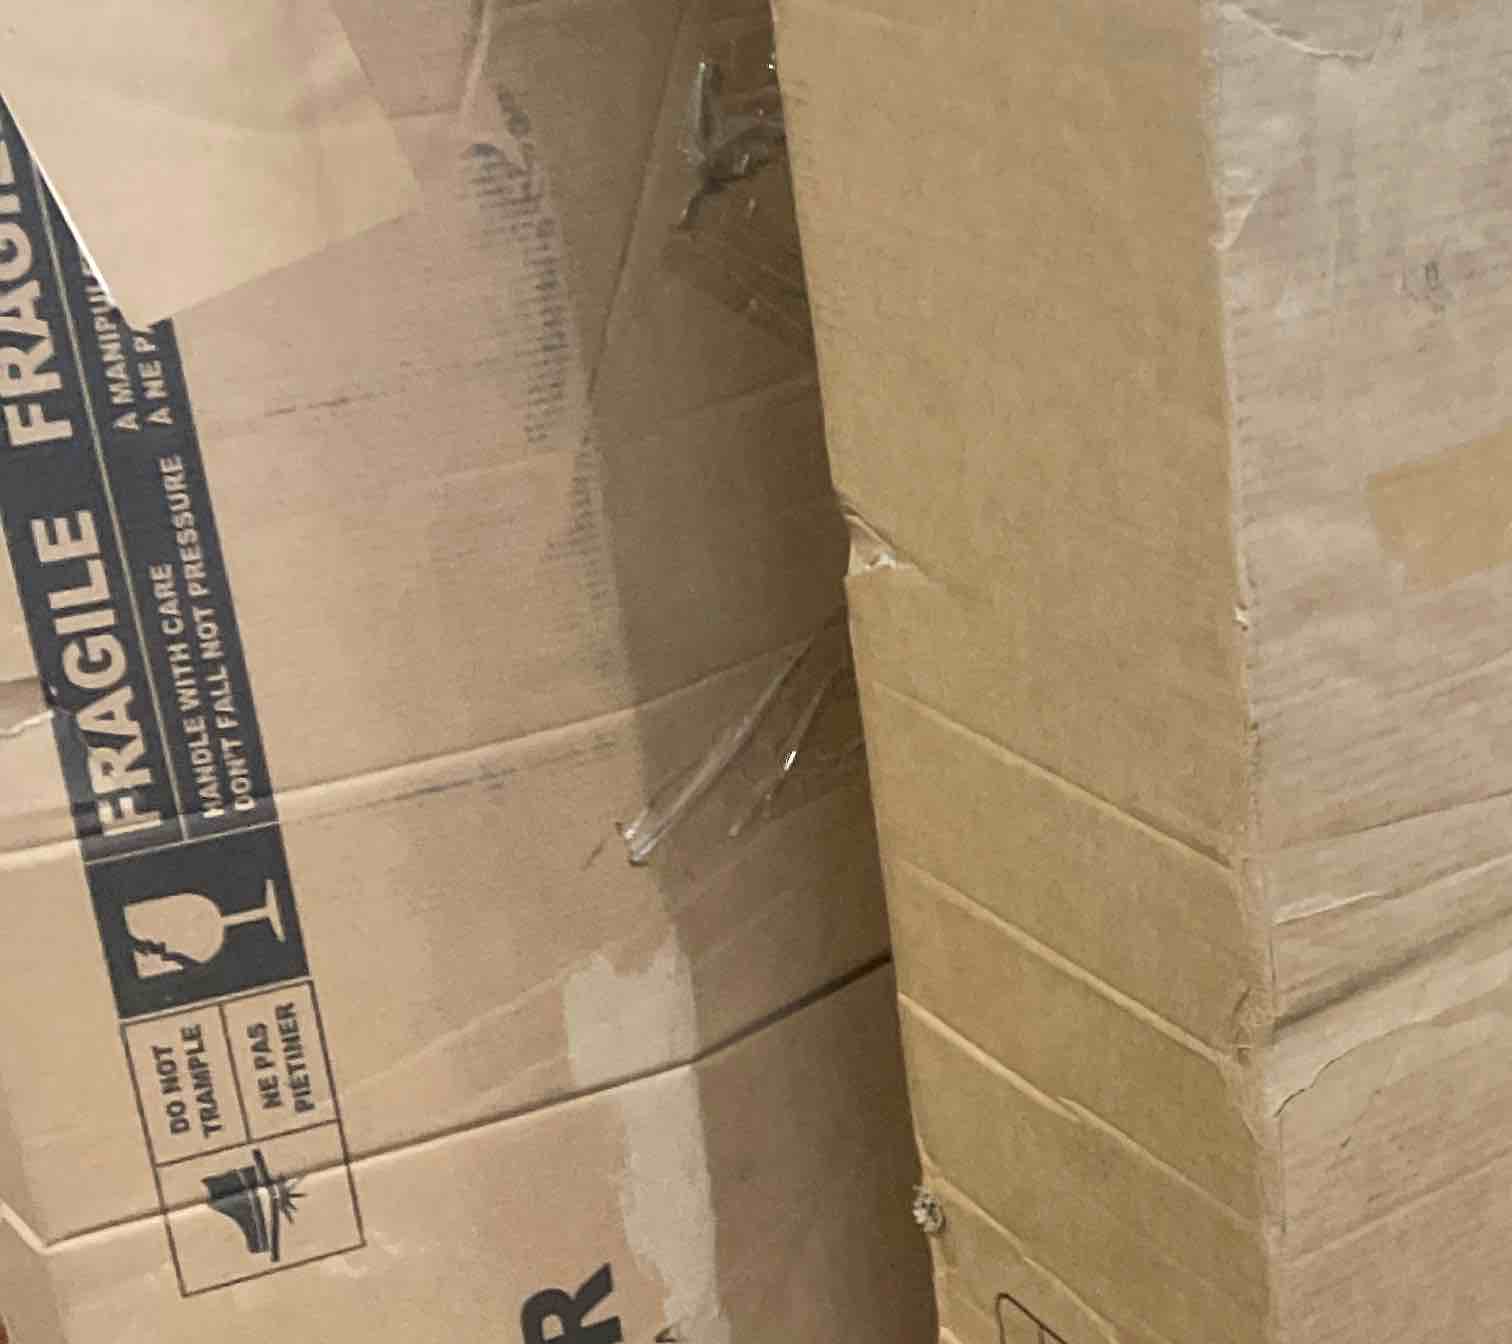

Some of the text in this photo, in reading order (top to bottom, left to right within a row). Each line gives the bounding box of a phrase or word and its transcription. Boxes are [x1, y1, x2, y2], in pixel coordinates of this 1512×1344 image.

[137, 359, 169, 400] NE
[31, 509, 162, 837] FRAGILE
[149, 561, 225, 819] HANDLE WITH CARE
[159, 453, 257, 813] DON'T FALL NOT PRESSURE
[152, 1044, 191, 1136] DO NOT
[180, 1023, 223, 1138] TRAMPLE
[246, 1022, 282, 1110] NE PAS
